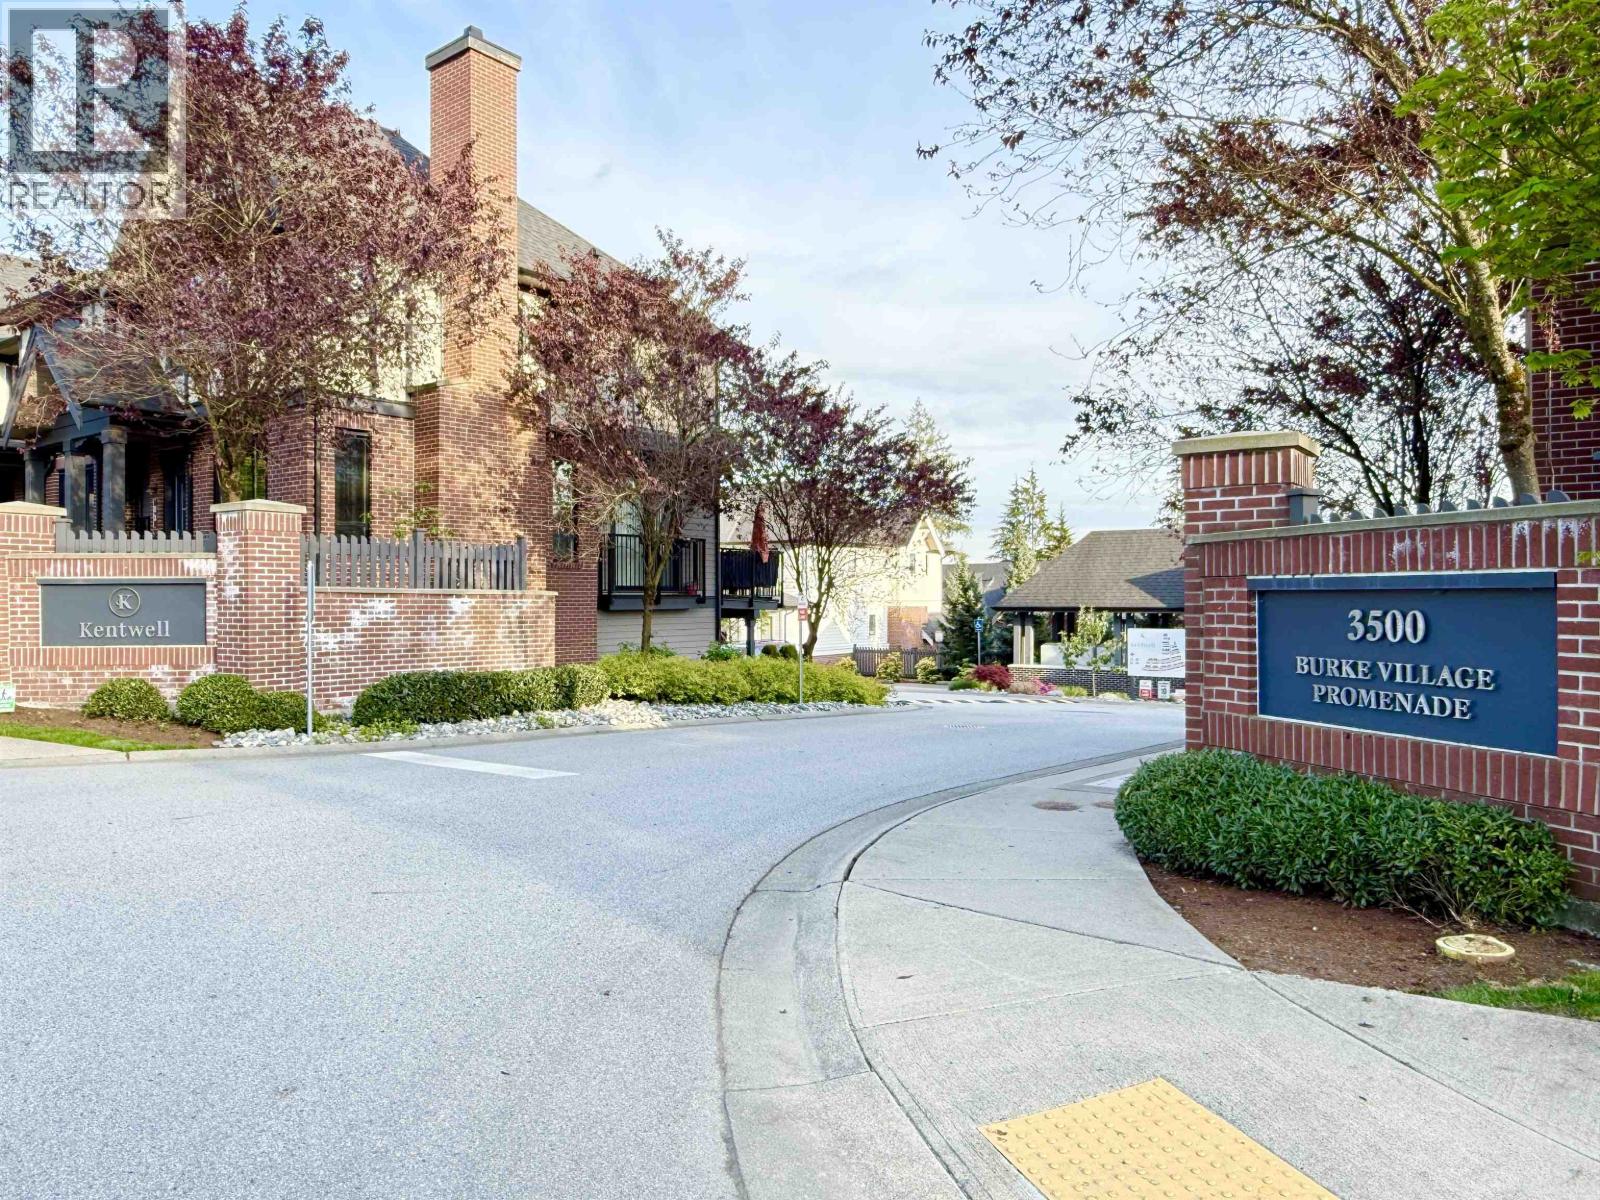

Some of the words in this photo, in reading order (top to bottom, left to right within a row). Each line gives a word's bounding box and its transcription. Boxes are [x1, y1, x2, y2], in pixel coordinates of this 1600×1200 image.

[115, 594, 134, 610] K
[79, 621, 170, 637] Kentwell
[1347, 609, 1426, 644] 3500
[1295, 656, 1373, 680] BURKE
[1376, 661, 1495, 691] VILLAGE
[1312, 684, 1472, 720] PROMENADE
